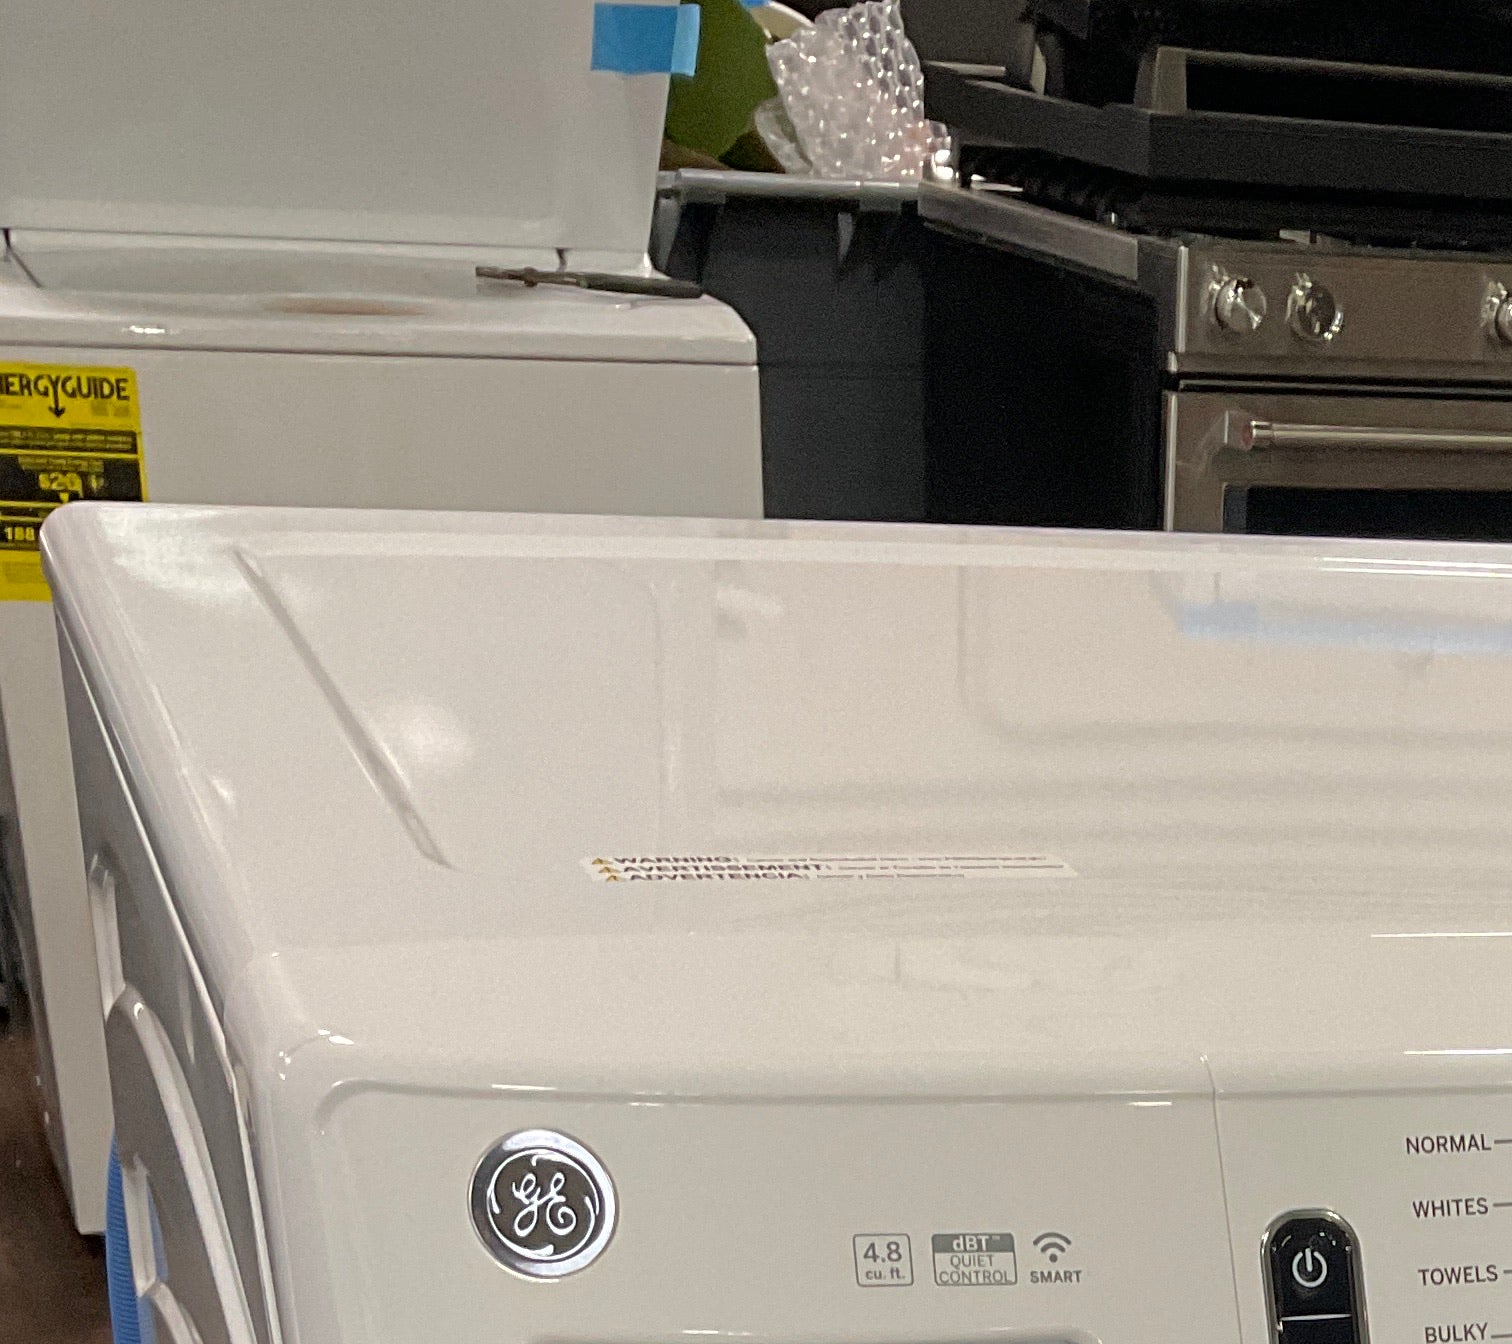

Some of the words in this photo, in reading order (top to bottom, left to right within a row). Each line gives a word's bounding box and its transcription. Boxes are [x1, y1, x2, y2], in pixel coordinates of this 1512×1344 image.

[614, 856, 732, 864] WARNING
[1405, 1134, 1492, 1155] NORMAL
[1412, 1197, 1489, 1218] WHITES
[863, 1241, 902, 1263] 4.8
[950, 1254, 995, 1268] QUIET
[865, 1270, 887, 1281] cu.
[890, 1267, 906, 1280] ft.
[939, 1270, 1014, 1285] CONTROL
[1030, 1270, 1082, 1284] SMART
[1418, 1265, 1498, 1287] TOWELS
[1424, 1322, 1489, 1344] BULKY
